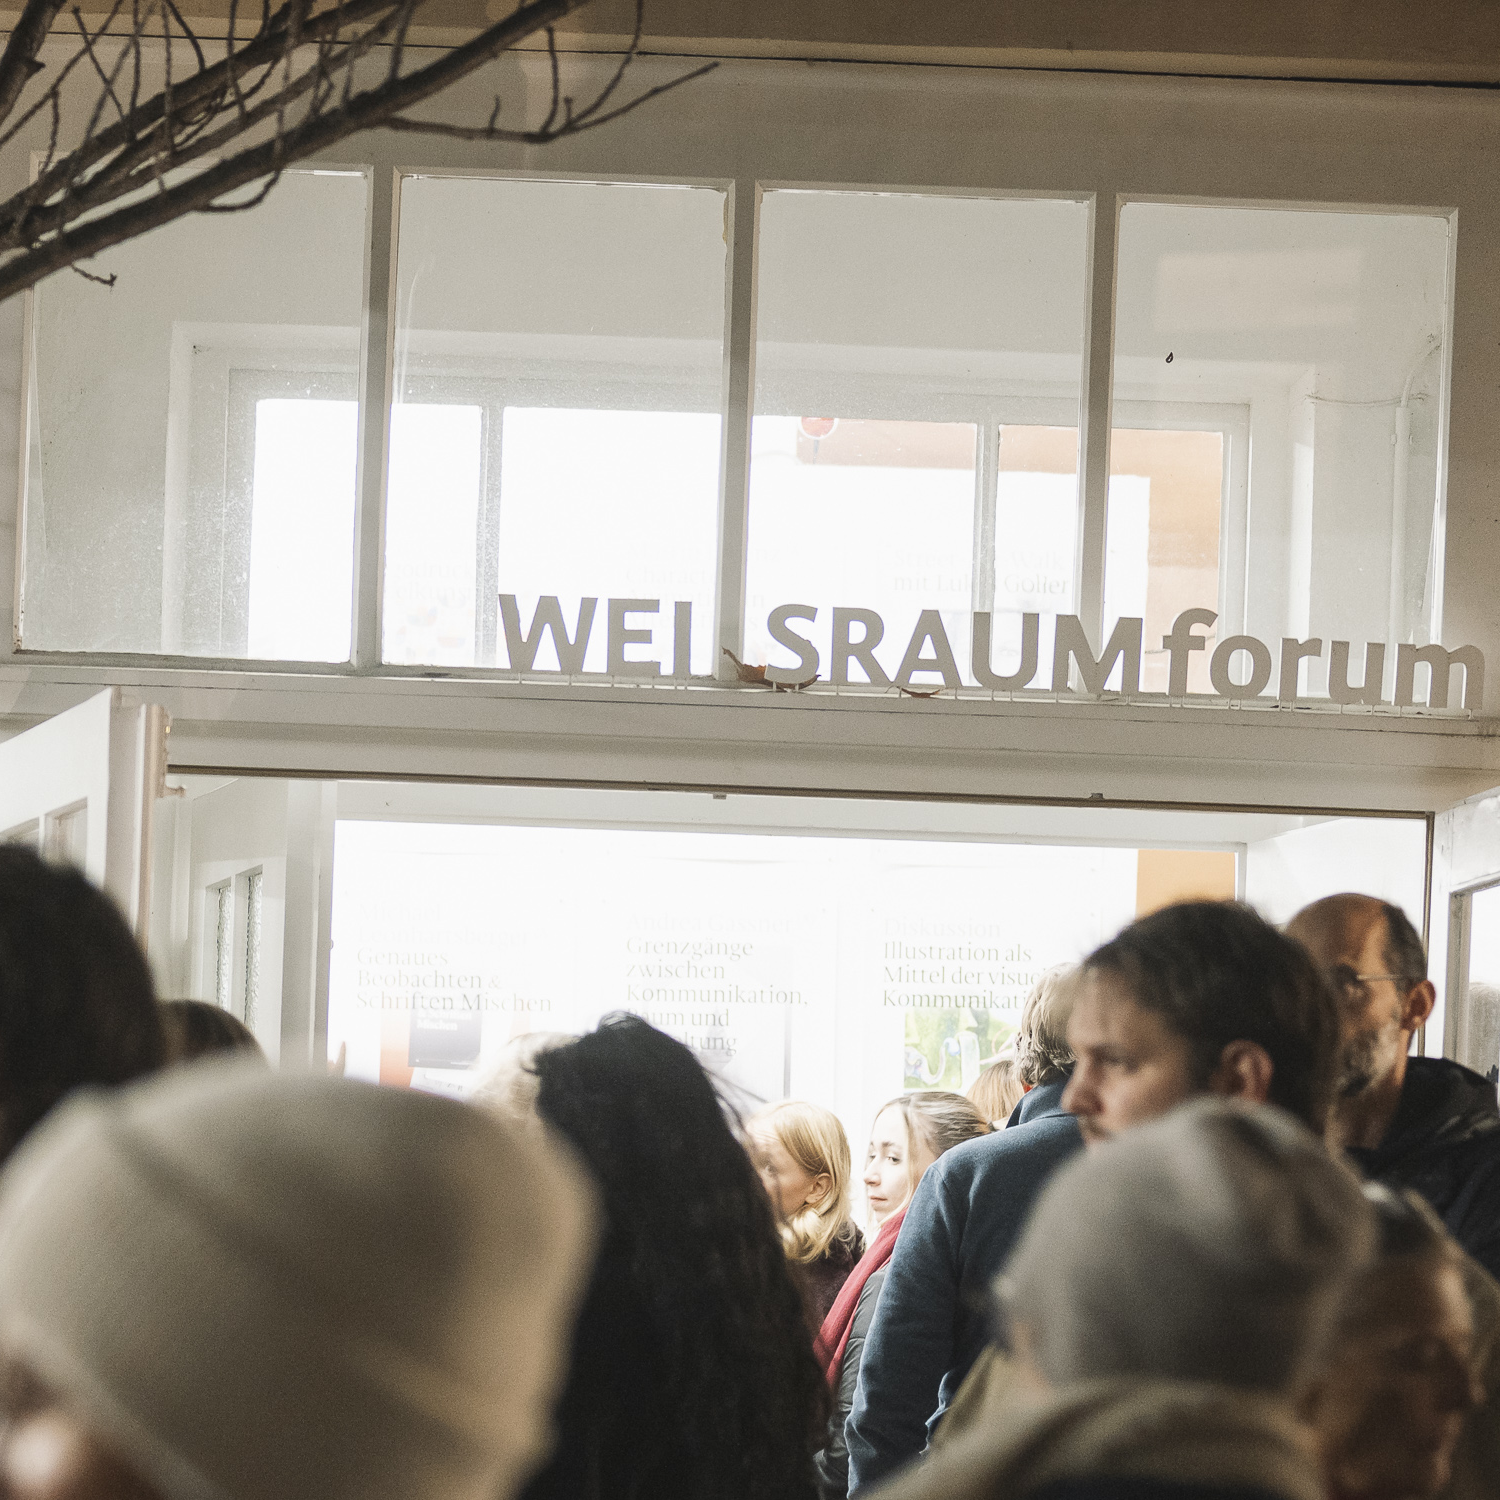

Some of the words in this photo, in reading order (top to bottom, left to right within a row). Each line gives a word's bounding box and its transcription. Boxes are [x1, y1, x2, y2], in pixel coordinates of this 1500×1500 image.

[884, 917, 1001, 938] Diskussion
[357, 947, 449, 966] Genaues
[626, 937, 754, 961] Grenzgänge
[884, 941, 1000, 961] Illustration
[1004, 943, 1032, 962] als
[357, 969, 483, 988] Beobachten
[487, 974, 504, 989] &
[626, 958, 725, 979] zwischen
[883, 964, 946, 984] Mittel
[951, 965, 986, 985] der
[356, 990, 455, 1010] Schriften
[460, 992, 552, 1012] Mischen
[626, 983, 808, 1008] Kommunikation,
[882, 989, 1027, 1010] Kommunikati
[691, 1008, 730, 1027] und
